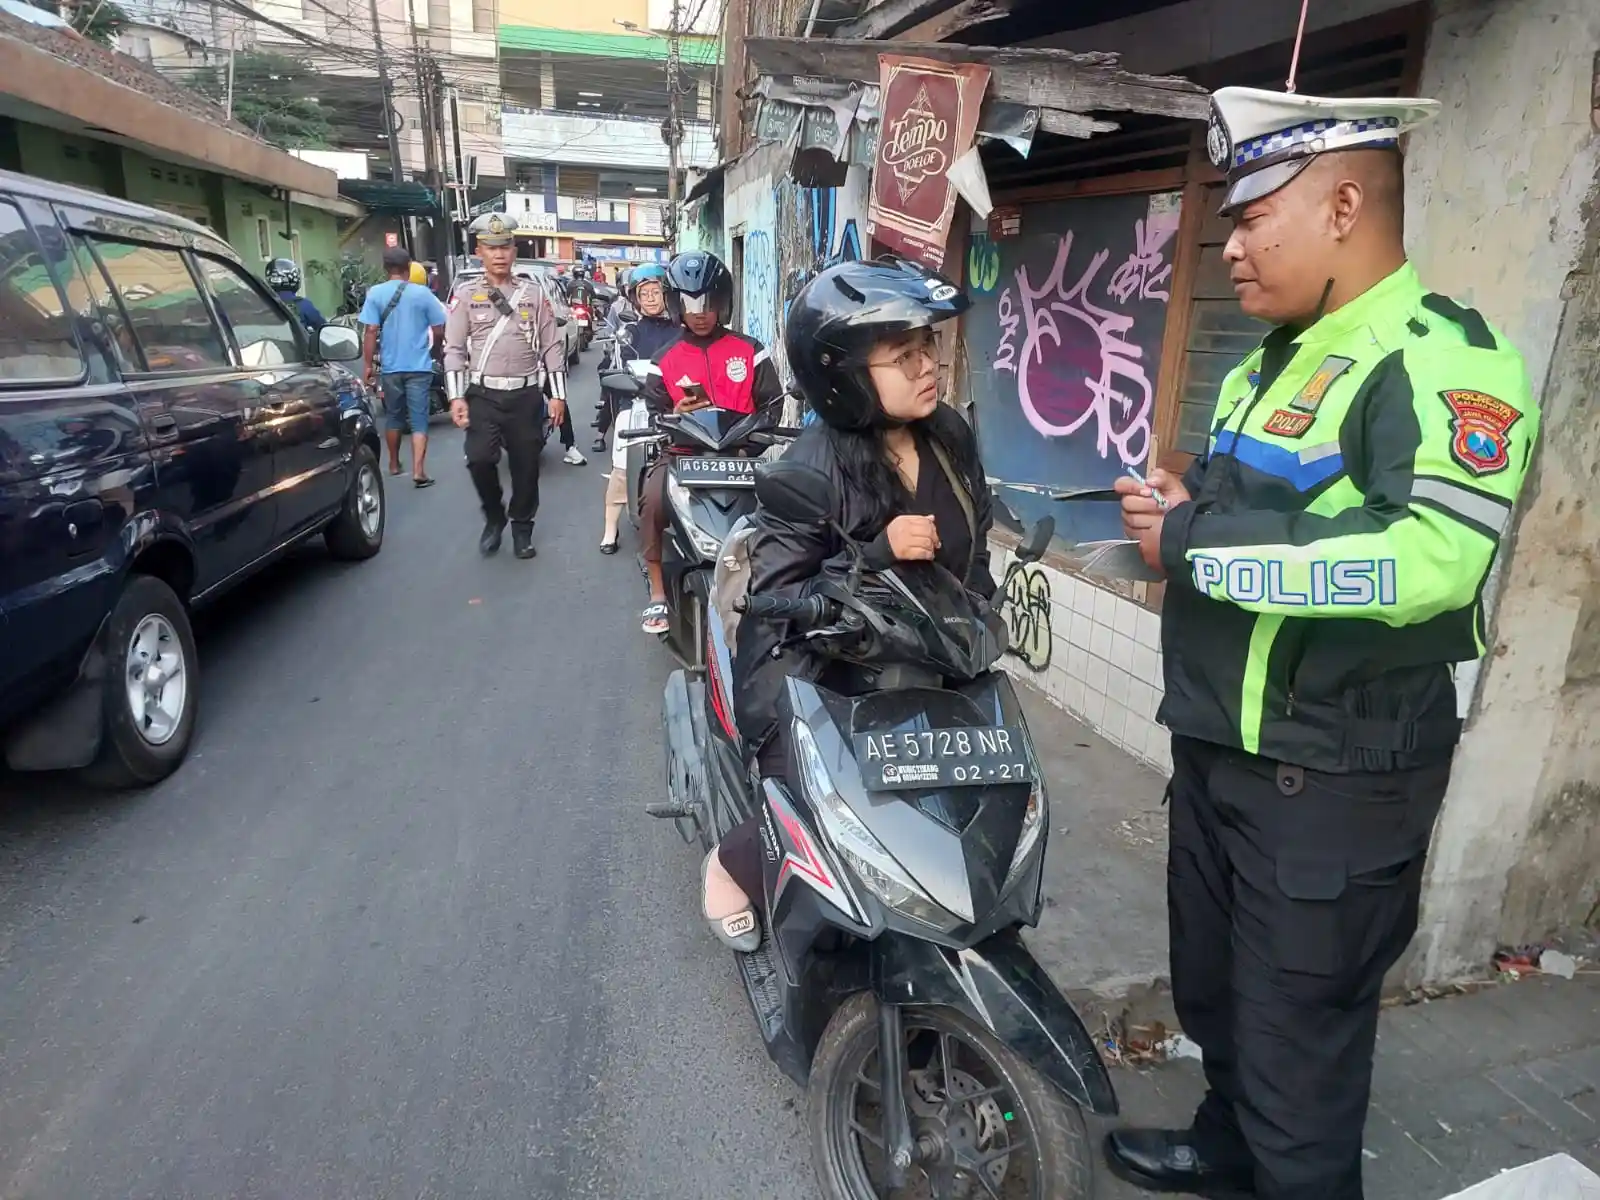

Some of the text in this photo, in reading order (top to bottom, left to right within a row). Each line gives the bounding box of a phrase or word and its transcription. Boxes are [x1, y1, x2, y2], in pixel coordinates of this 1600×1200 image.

[889, 116, 948, 159] Tempo
[1192, 554, 1397, 606] POLISI
[867, 729, 1013, 760] AE 5728 NR
